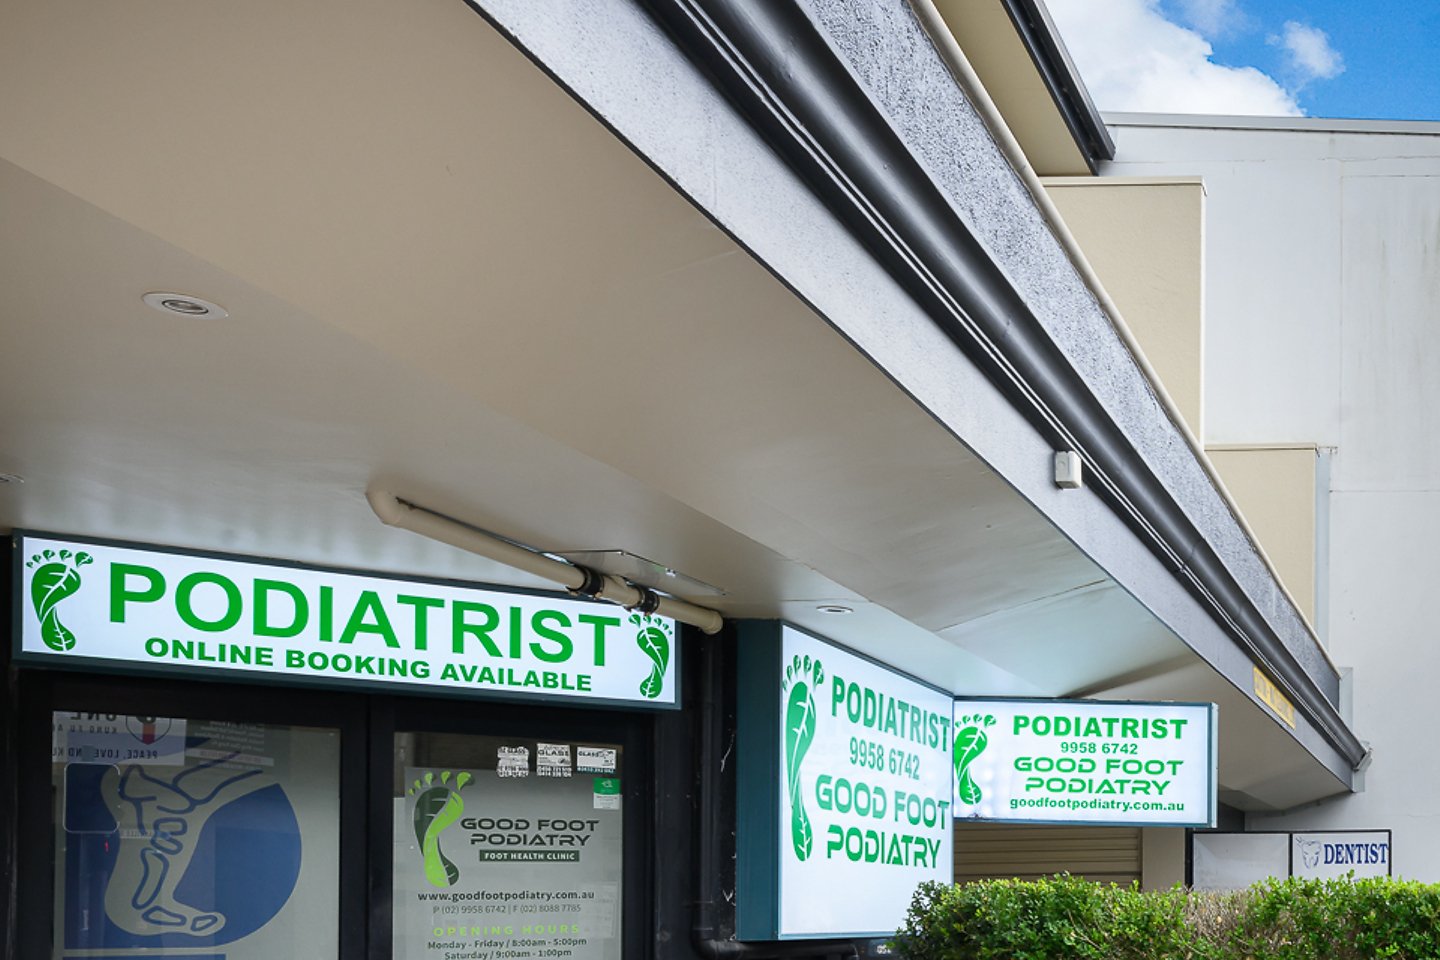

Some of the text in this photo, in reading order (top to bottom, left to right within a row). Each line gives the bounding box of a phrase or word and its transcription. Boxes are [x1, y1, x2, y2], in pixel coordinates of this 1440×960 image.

[109, 561, 622, 667] PODIATRIST
[144, 637, 593, 693] ONLINE BOOKING AVAILABLE
[831, 675, 951, 754] PODIATRIST
[1013, 715, 1189, 740] PODIATRIST
[1060, 741, 1138, 755] 9958 6742
[849, 735, 920, 782] 9958 6742
[1013, 756, 1184, 776] GOOD FOOT
[1025, 776, 1171, 796] PODIATRY
[815, 774, 951, 831] GOOD FOOT
[1009, 797, 1185, 813] goodfootpodiatry.com.au
[460, 818, 599, 831] GOOD FOOT
[470, 833, 591, 846] PODIATRY
[827, 824, 941, 869] PODIATRY
[485, 852, 576, 860] FOOT HEALTH CLINIC
[1324, 843, 1388, 865] DENTIST
[417, 890, 595, 902] www.goodfootpodiatry.com.au
[441, 905, 460, 915] (02)
[461, 905, 484, 914] 9958
[485, 905, 506, 914] 6742
[520, 904, 537, 914] (02)
[561, 903, 581, 912] 7785
[433, 924, 580, 937] OPENING HOURS
[427, 941, 467, 951] Monday
[474, 939, 504, 949] Friday
[553, 938, 587, 948] 5:00pm
[444, 951, 488, 960] Saturday
[495, 950, 530, 959] 9:00am
[538, 948, 572, 958] 1:00pm
